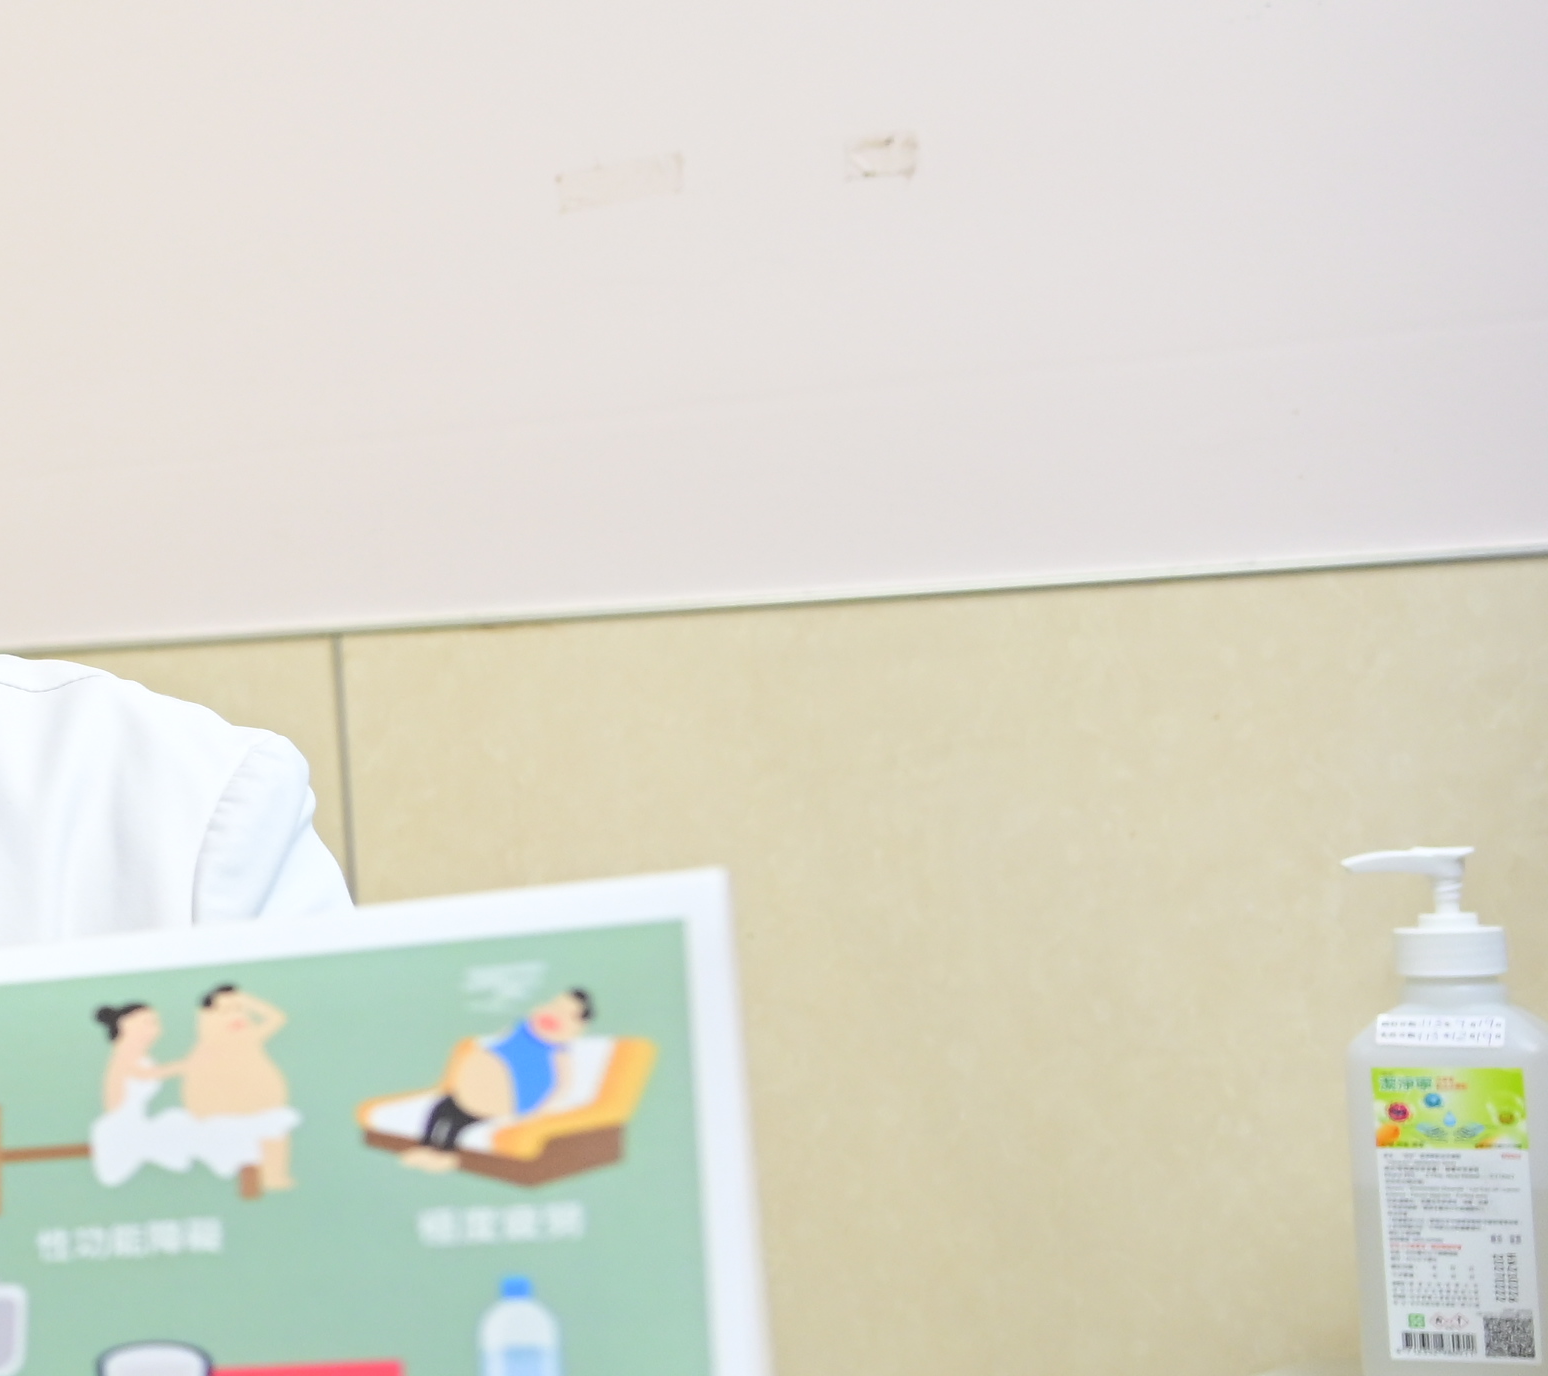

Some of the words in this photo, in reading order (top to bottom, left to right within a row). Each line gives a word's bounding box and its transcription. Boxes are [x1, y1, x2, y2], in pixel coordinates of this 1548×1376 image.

[37, 1218, 222, 1261] 性功能障礙
